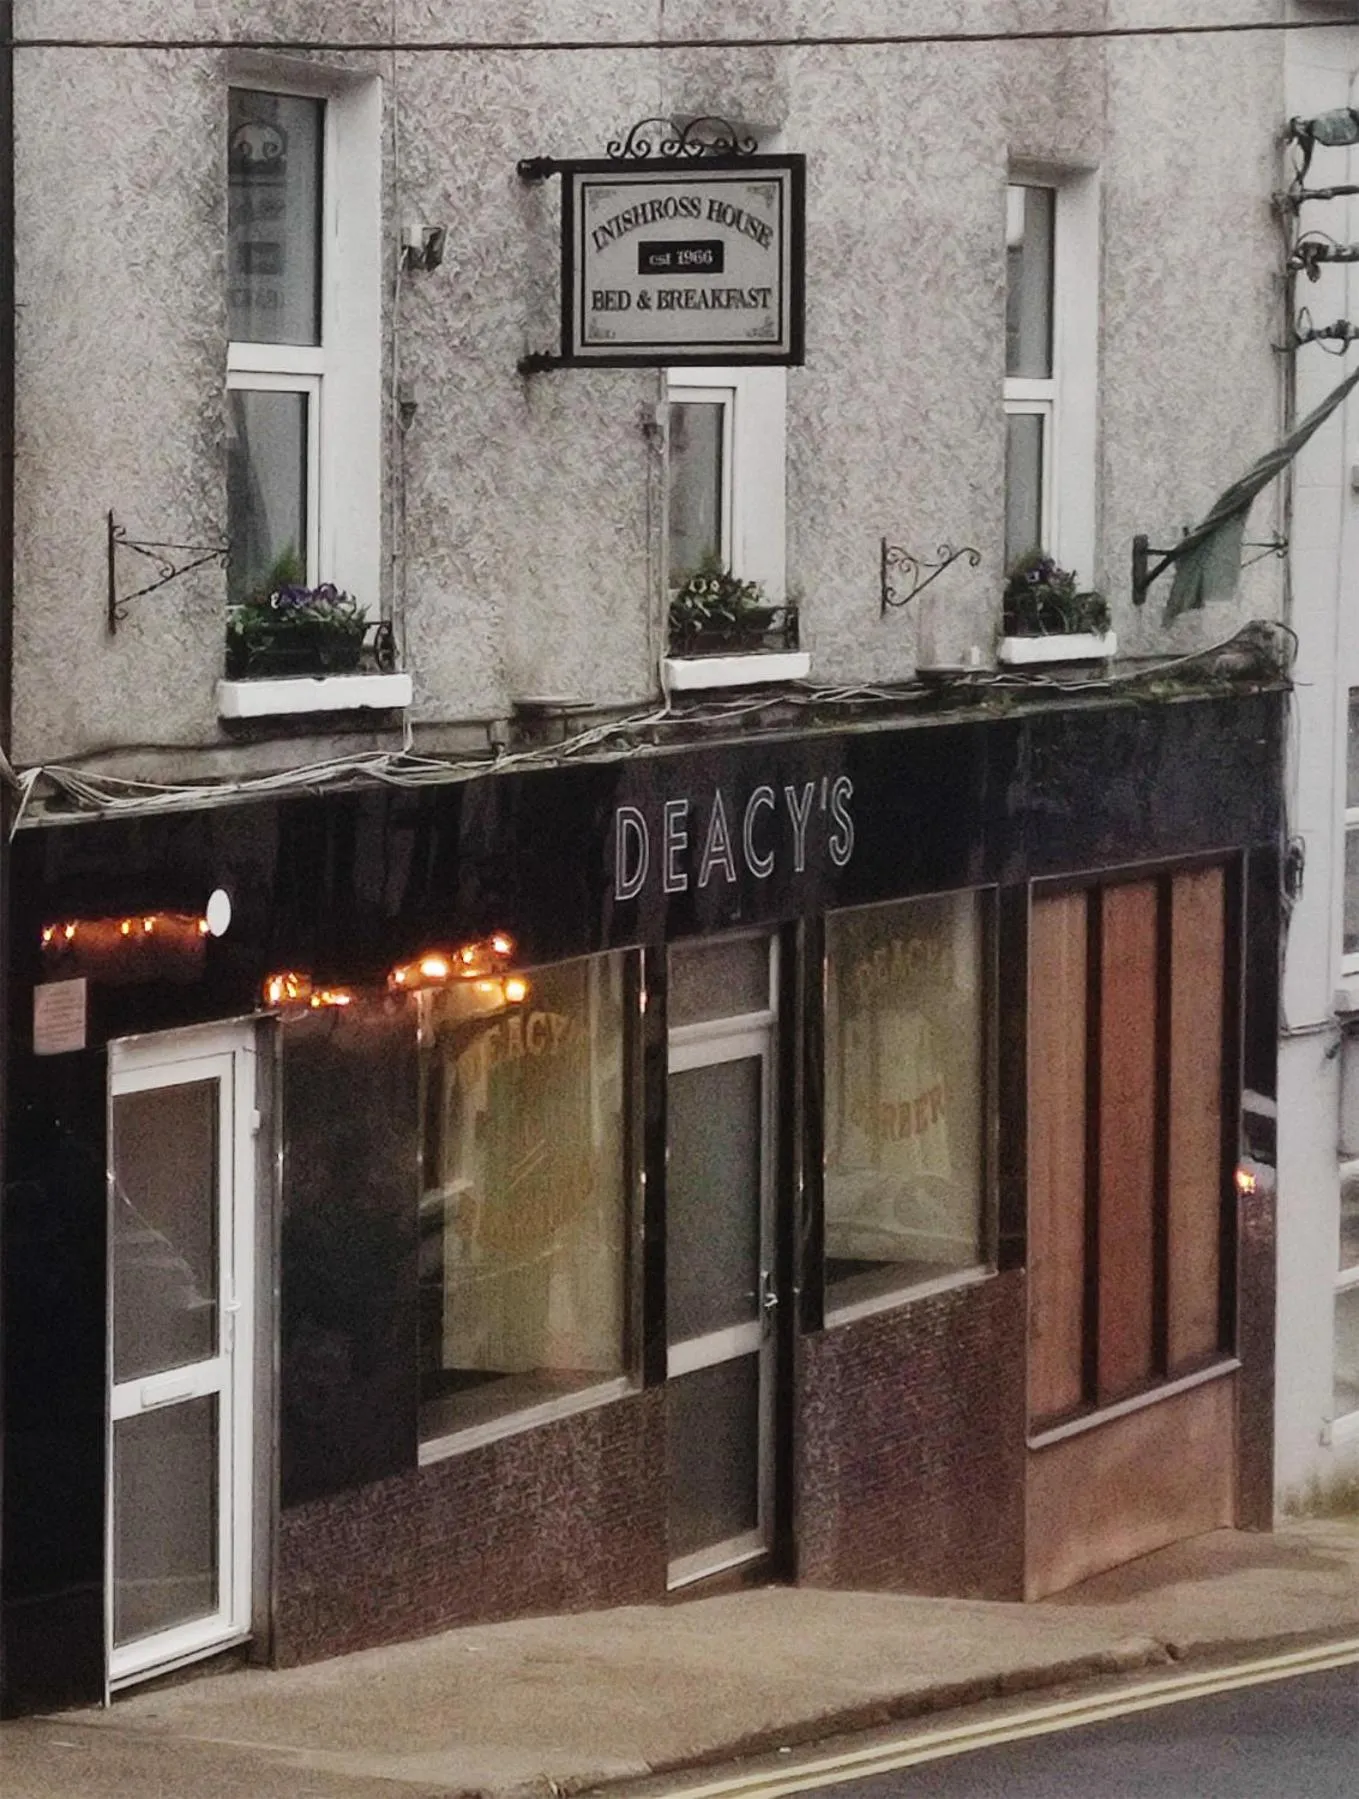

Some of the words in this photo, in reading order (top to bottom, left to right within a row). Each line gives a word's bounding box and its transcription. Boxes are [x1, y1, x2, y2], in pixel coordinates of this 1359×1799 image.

[591, 196, 702, 254] INISHROSS
[707, 198, 774, 250] HOUSE
[649, 252, 671, 267] est
[591, 290, 632, 312] BED
[636, 290, 652, 311] &
[656, 287, 772, 311] BREAKFAST
[614, 775, 855, 900] DEACY'S
